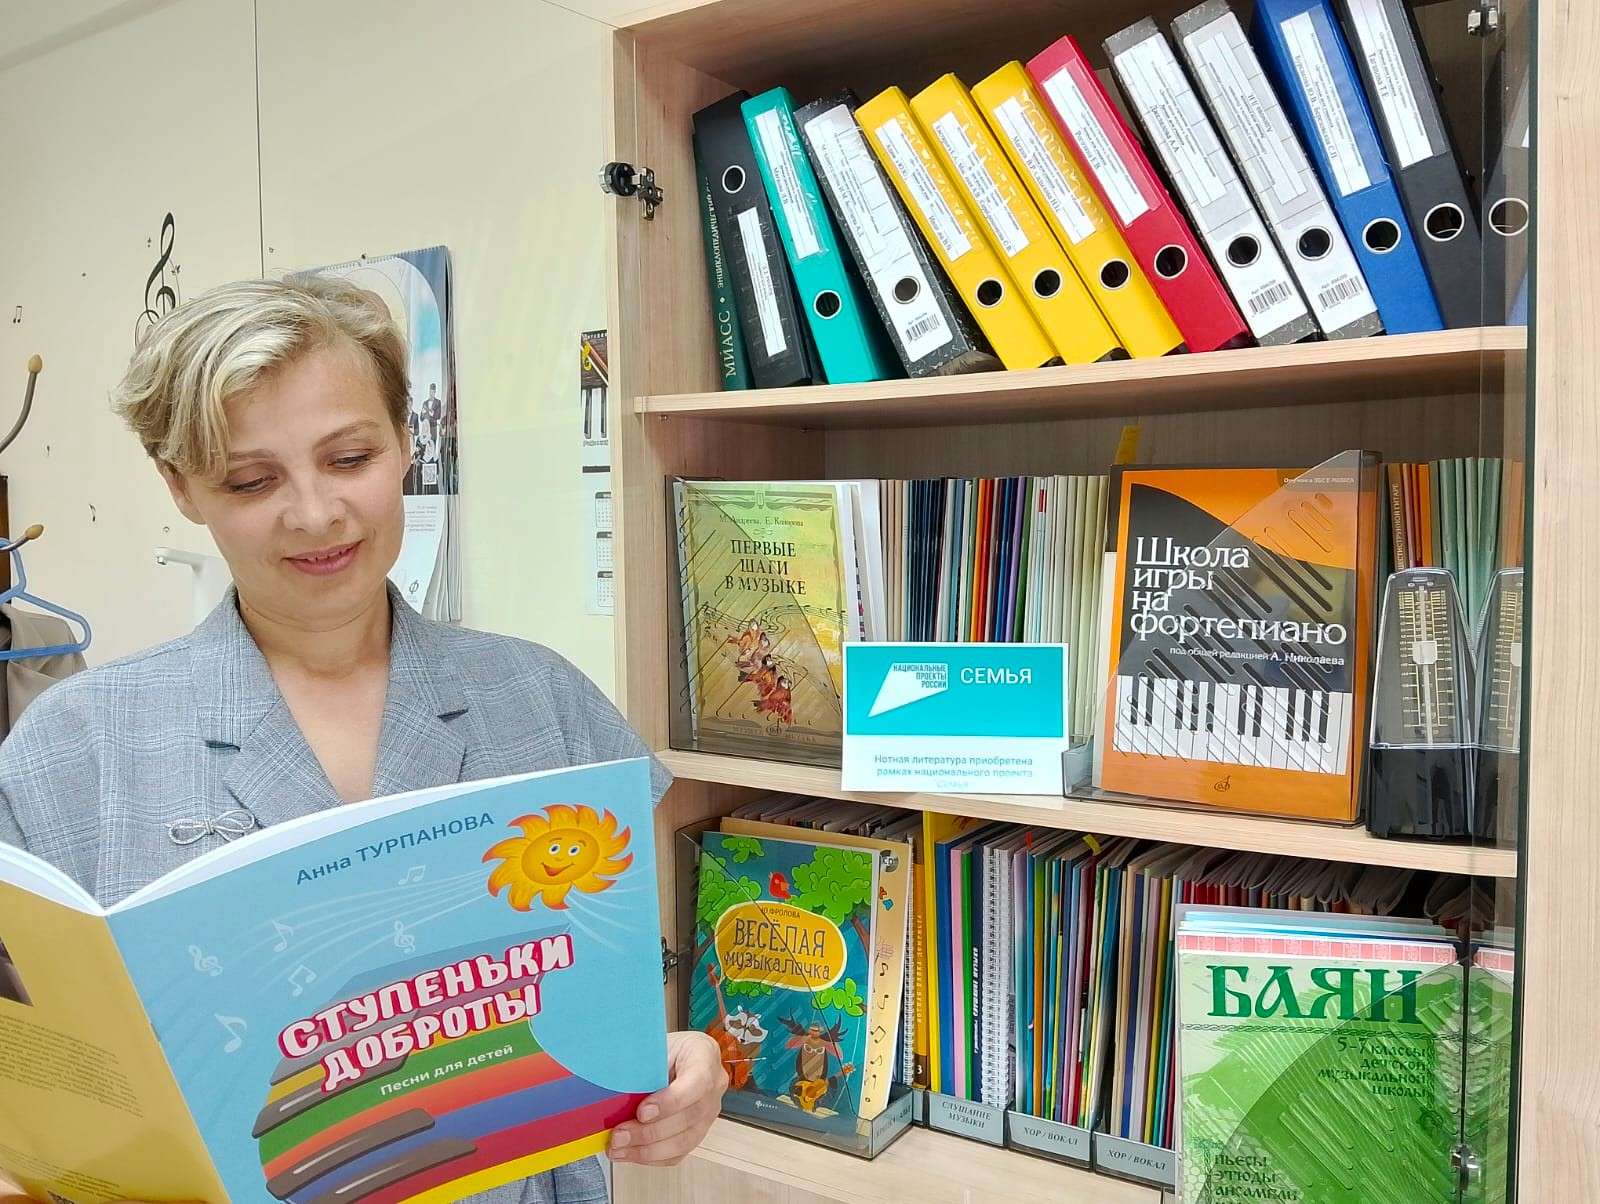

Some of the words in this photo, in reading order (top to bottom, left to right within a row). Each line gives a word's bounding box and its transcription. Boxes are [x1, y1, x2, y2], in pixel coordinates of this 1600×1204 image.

[730, 539, 796, 558] ПЕРВЫЕ
[1135, 536, 1250, 568] Школа
[740, 558, 788, 576] ШАГИ
[725, 575, 734, 590] В
[738, 576, 807, 596] МУЗЫКЕ
[1133, 568, 1213, 596] игры
[1132, 590, 1169, 612] на
[1130, 604, 1347, 645] фортепиано
[1169, 647, 1187, 656] под
[1189, 648, 1218, 658] общей
[1219, 650, 1269, 661] редакцией
[1270, 652, 1282, 662] А.
[1284, 653, 1345, 666] Николаева
[893, 664, 946, 673] НАЦИОНАЛЬНЫЕ
[915, 672, 947, 681] ПРОЕКТЫ
[959, 667, 1032, 685] СЕМЬЯ
[921, 680, 947, 689] РОССИИ
[874, 754, 910, 764] Нотная
[911, 755, 967, 769] литература
[969, 756, 1033, 769] приобретена
[876, 767, 912, 777] рамках
[914, 768, 990, 779] национального
[295, 855, 352, 885] Анна
[355, 811, 495, 863] ТУРПАНОВА
[733, 917, 826, 958] ВЕСЁЛАЯ
[723, 951, 831, 980] музыкалочка
[279, 934, 573, 1059] СТУПЕНЬКИ
[1206, 965, 1423, 1025] БАЯН
[322, 983, 540, 1092] ДОБРОТЫ
[379, 1069, 430, 1097] Песни
[433, 1060, 464, 1083] для
[466, 1044, 514, 1069] детей
[916, 1064, 923, 1076] 3
[942, 1100, 992, 1121] СЛУШАНИЕ
[948, 1112, 985, 1129] МУЗЫКИ
[1023, 1127, 1041, 1138] ХОР
[1048, 1132, 1079, 1146] ВОКАЛ
[1107, 1149, 1127, 1161] ХОР
[1133, 1155, 1167, 1171] ВОКАЛ
